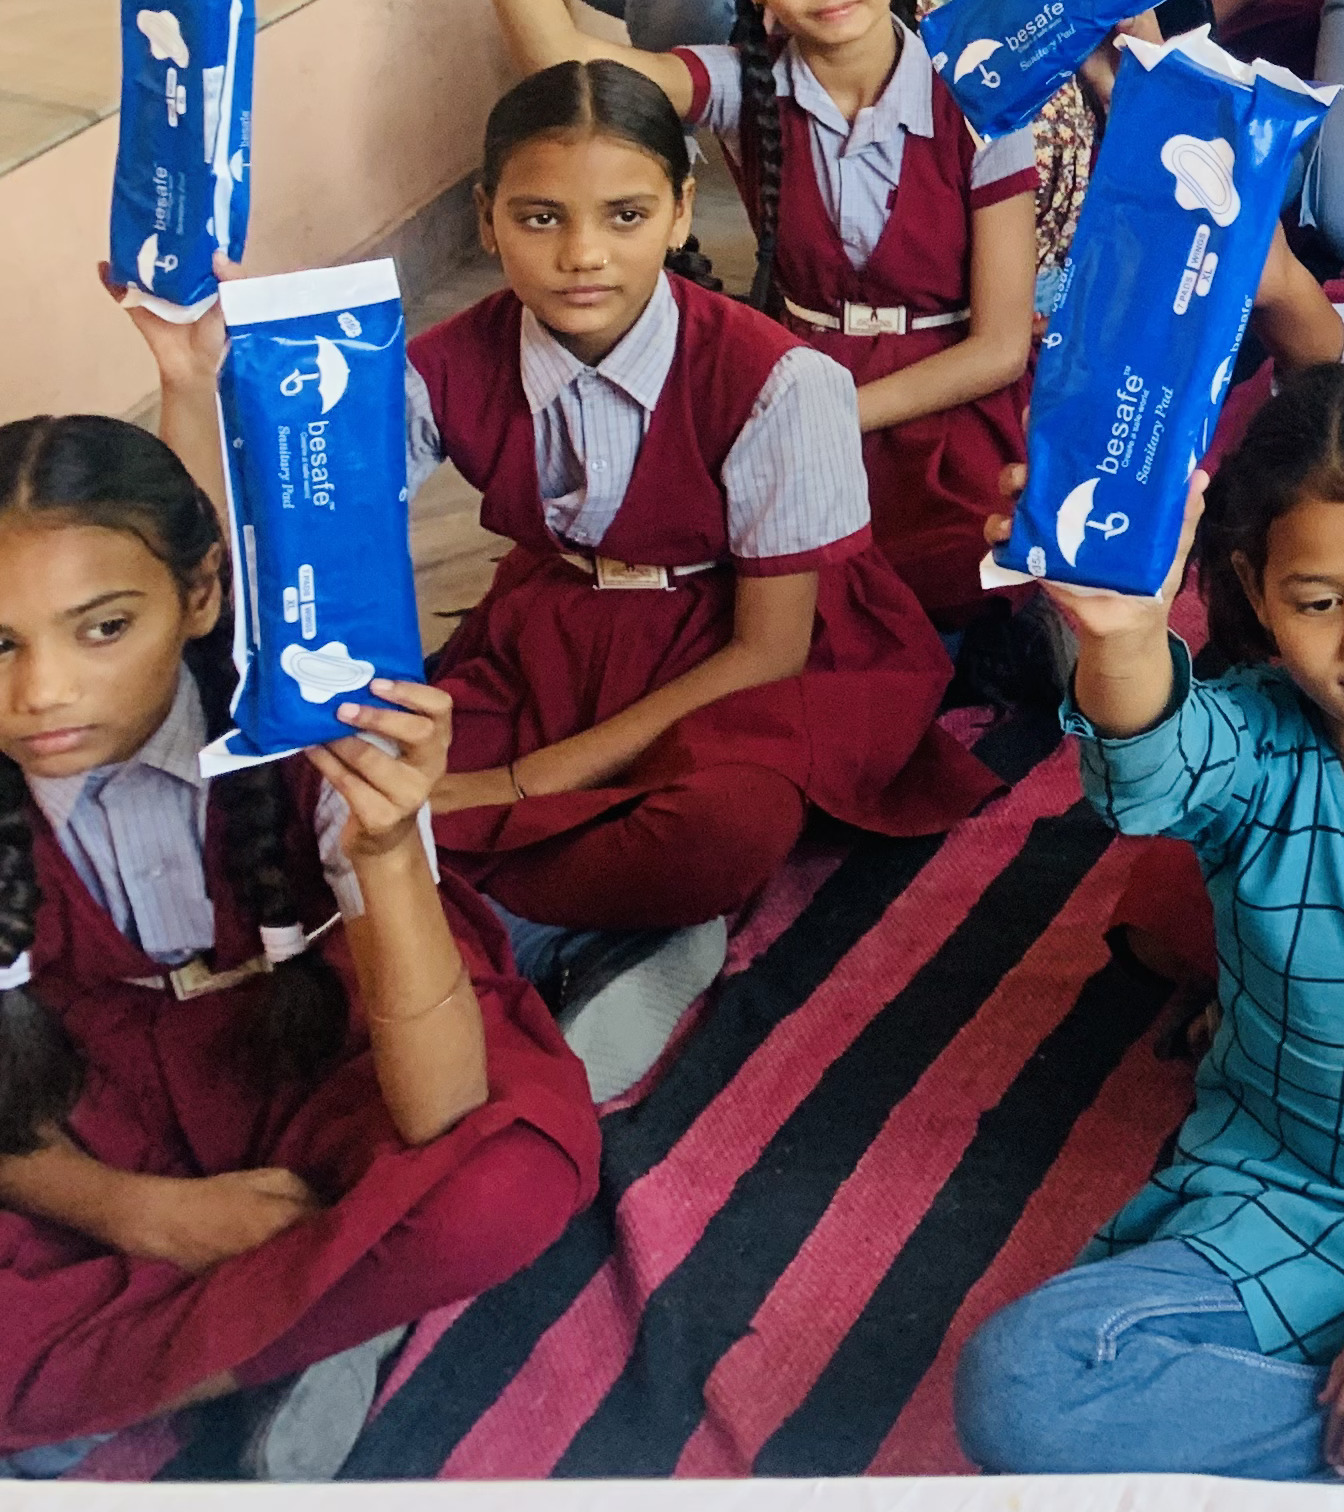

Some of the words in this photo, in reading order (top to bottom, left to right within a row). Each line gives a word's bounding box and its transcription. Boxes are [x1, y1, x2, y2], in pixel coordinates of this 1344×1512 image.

[152, 165, 168, 231] besafe
[1191, 232, 1206, 265] WINGS
[1179, 276, 1194, 303] PADS
[1201, 269, 1213, 283] XL
[1135, 419, 1165, 485] Sanitary
[1154, 385, 1174, 419] Pad
[308, 420, 335, 508] besafe
